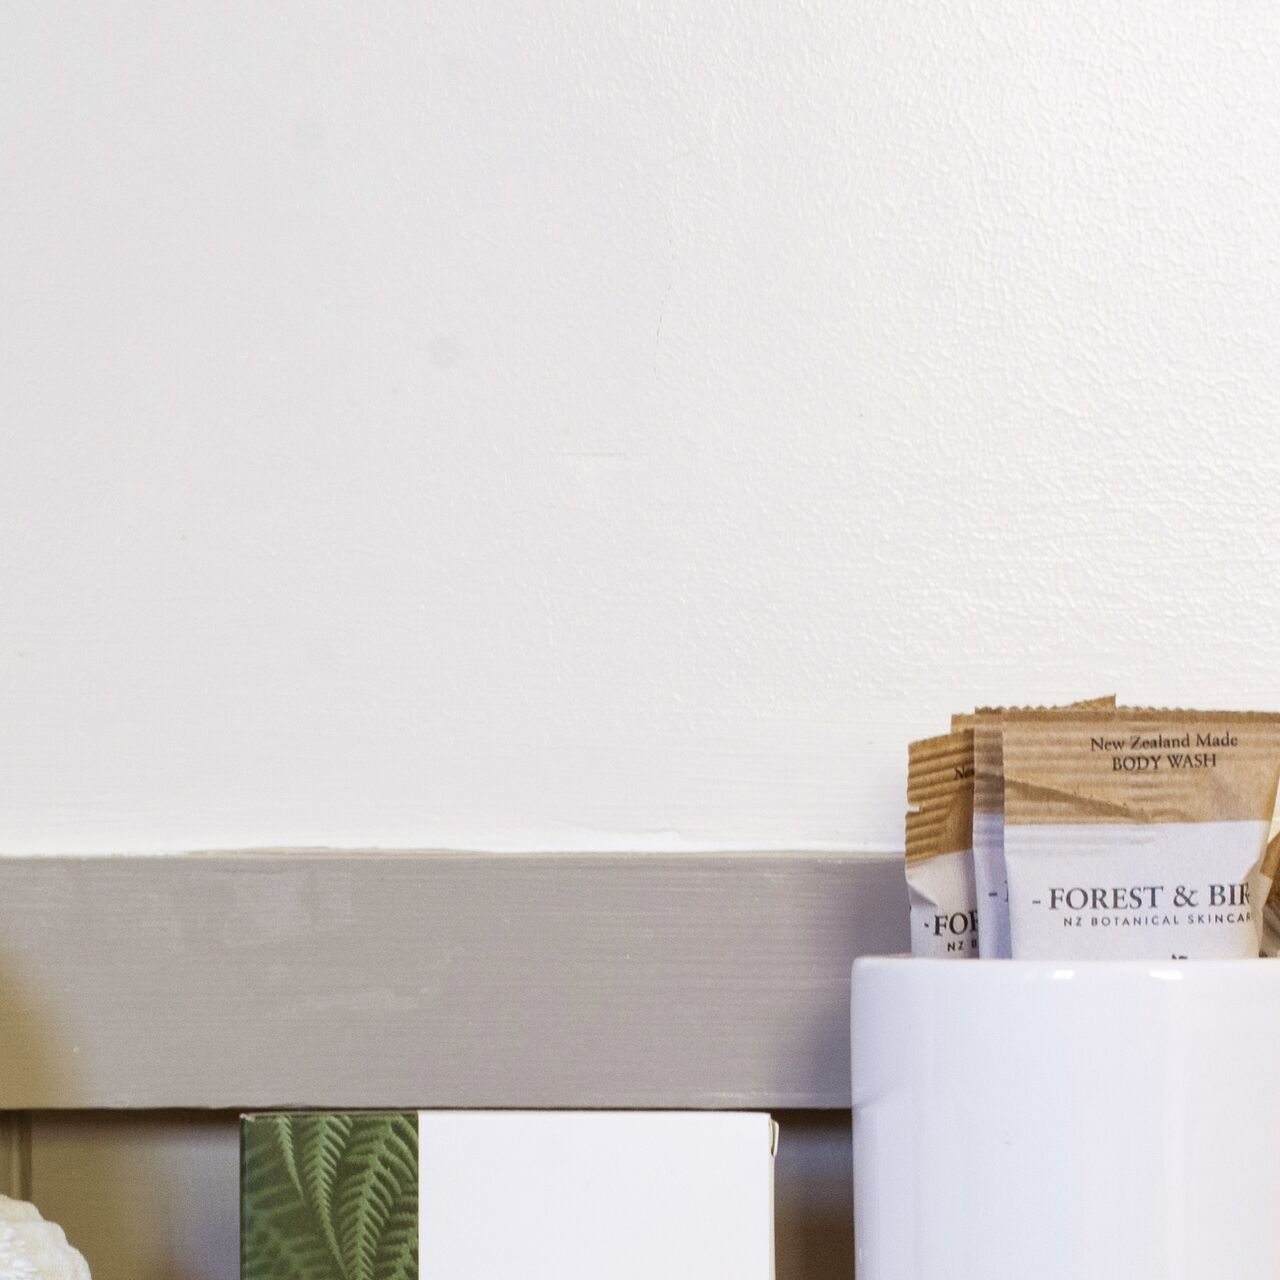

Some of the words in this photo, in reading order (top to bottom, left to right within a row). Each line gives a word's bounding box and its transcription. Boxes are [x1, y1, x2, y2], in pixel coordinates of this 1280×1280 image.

[1090, 736, 1125, 751] New
[1130, 735, 1190, 750] Zealand
[1195, 733, 1238, 749] Made
[1112, 755, 1163, 772] BODY
[1167, 754, 1217, 770] WASH
[1049, 888, 1163, 911] FOREST
[1173, 885, 1199, 908] &
[1064, 916, 1084, 927] NZ
[1091, 915, 1180, 926] BOTANICAL
